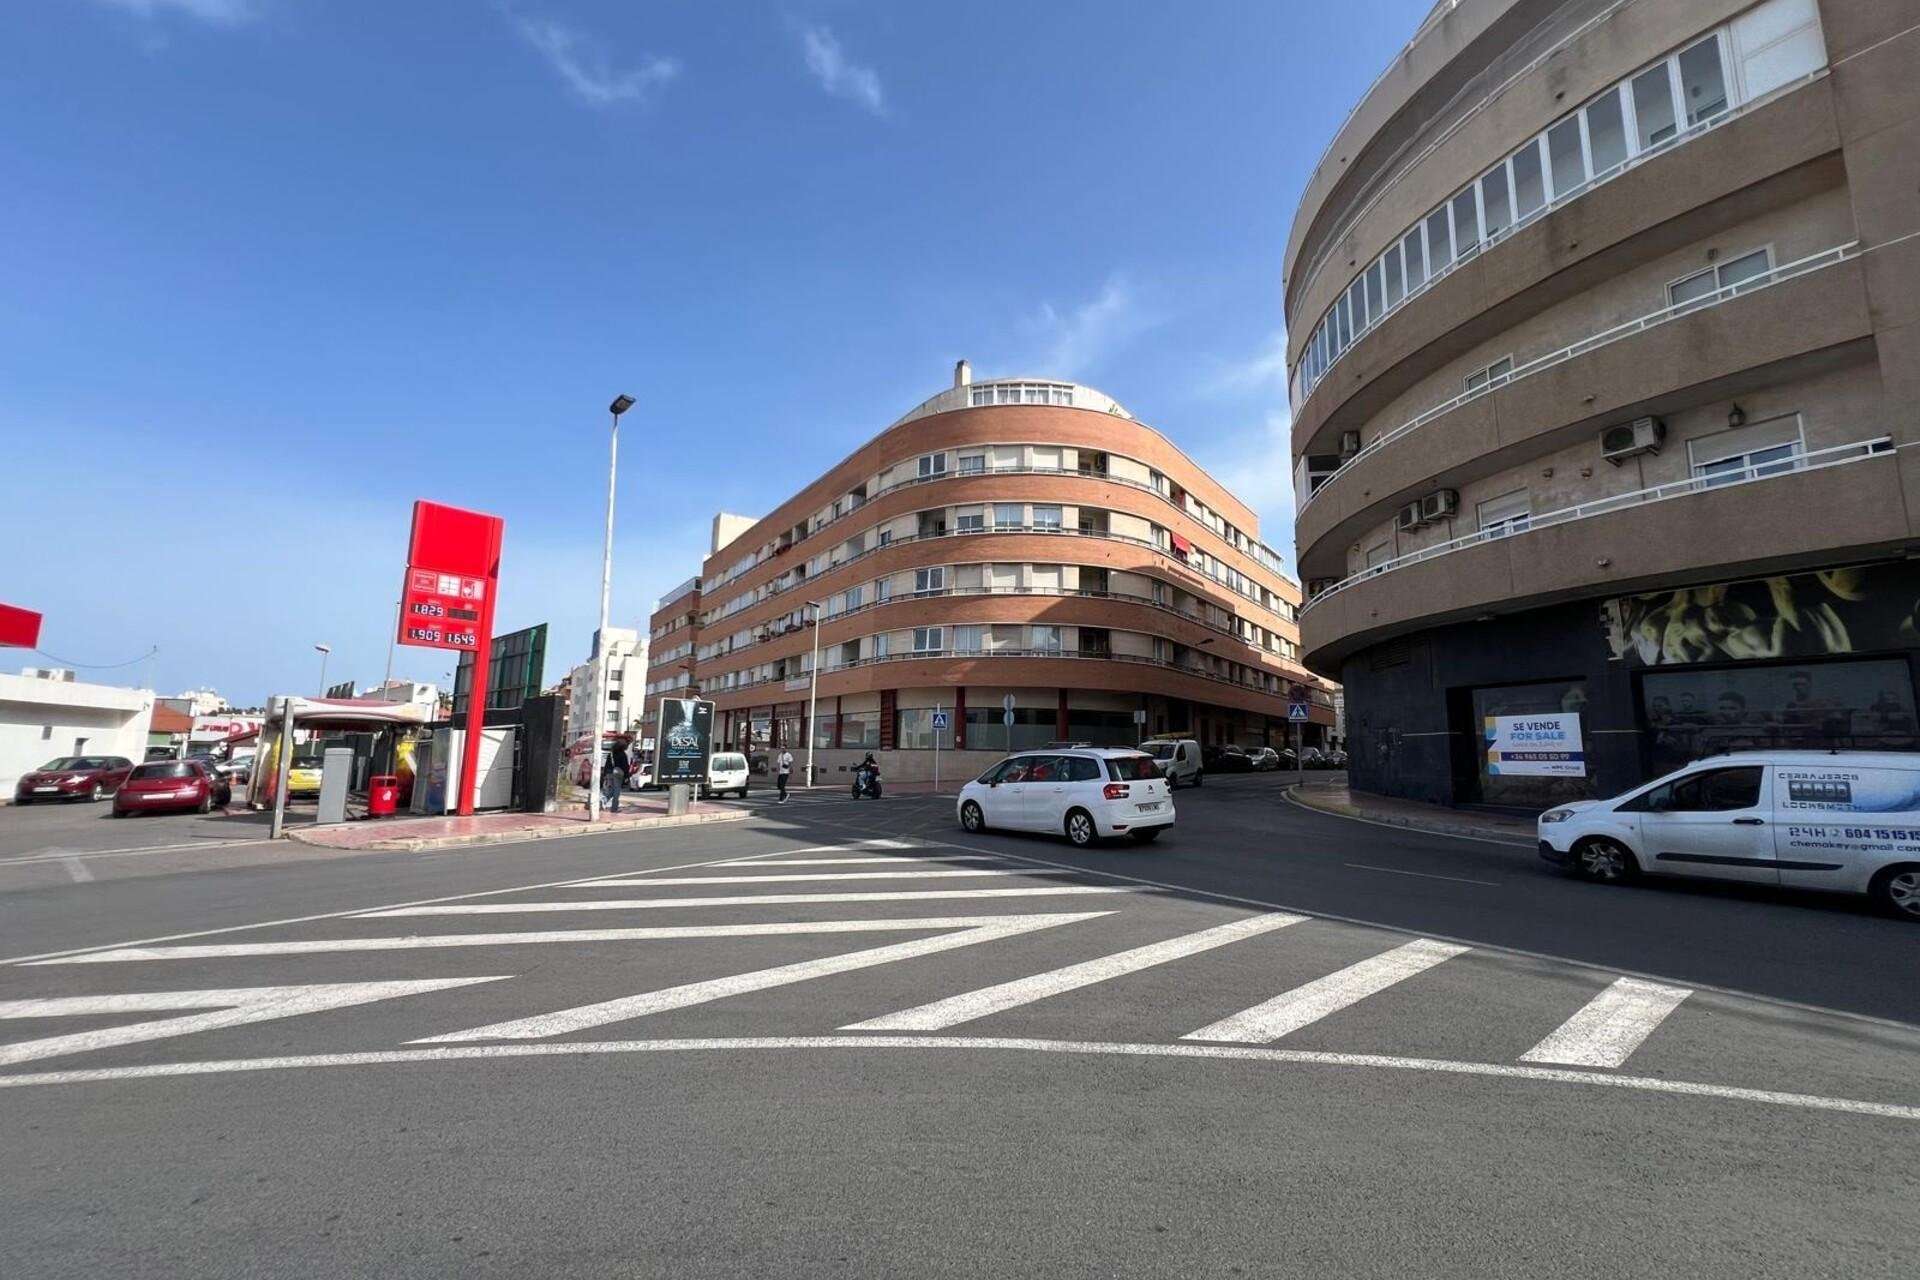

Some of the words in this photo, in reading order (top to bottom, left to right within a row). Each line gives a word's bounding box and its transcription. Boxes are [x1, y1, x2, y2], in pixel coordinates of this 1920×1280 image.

[414, 604, 444, 617] 1.829
[412, 629, 441, 642] 1.909
[448, 633, 476, 646] 1.649
[1513, 723, 1524, 731] SE
[1526, 721, 1560, 731] VENDE
[1510, 732, 1534, 740] FOR
[1535, 731, 1566, 740] SALE
[1789, 827, 1826, 838] 24H
